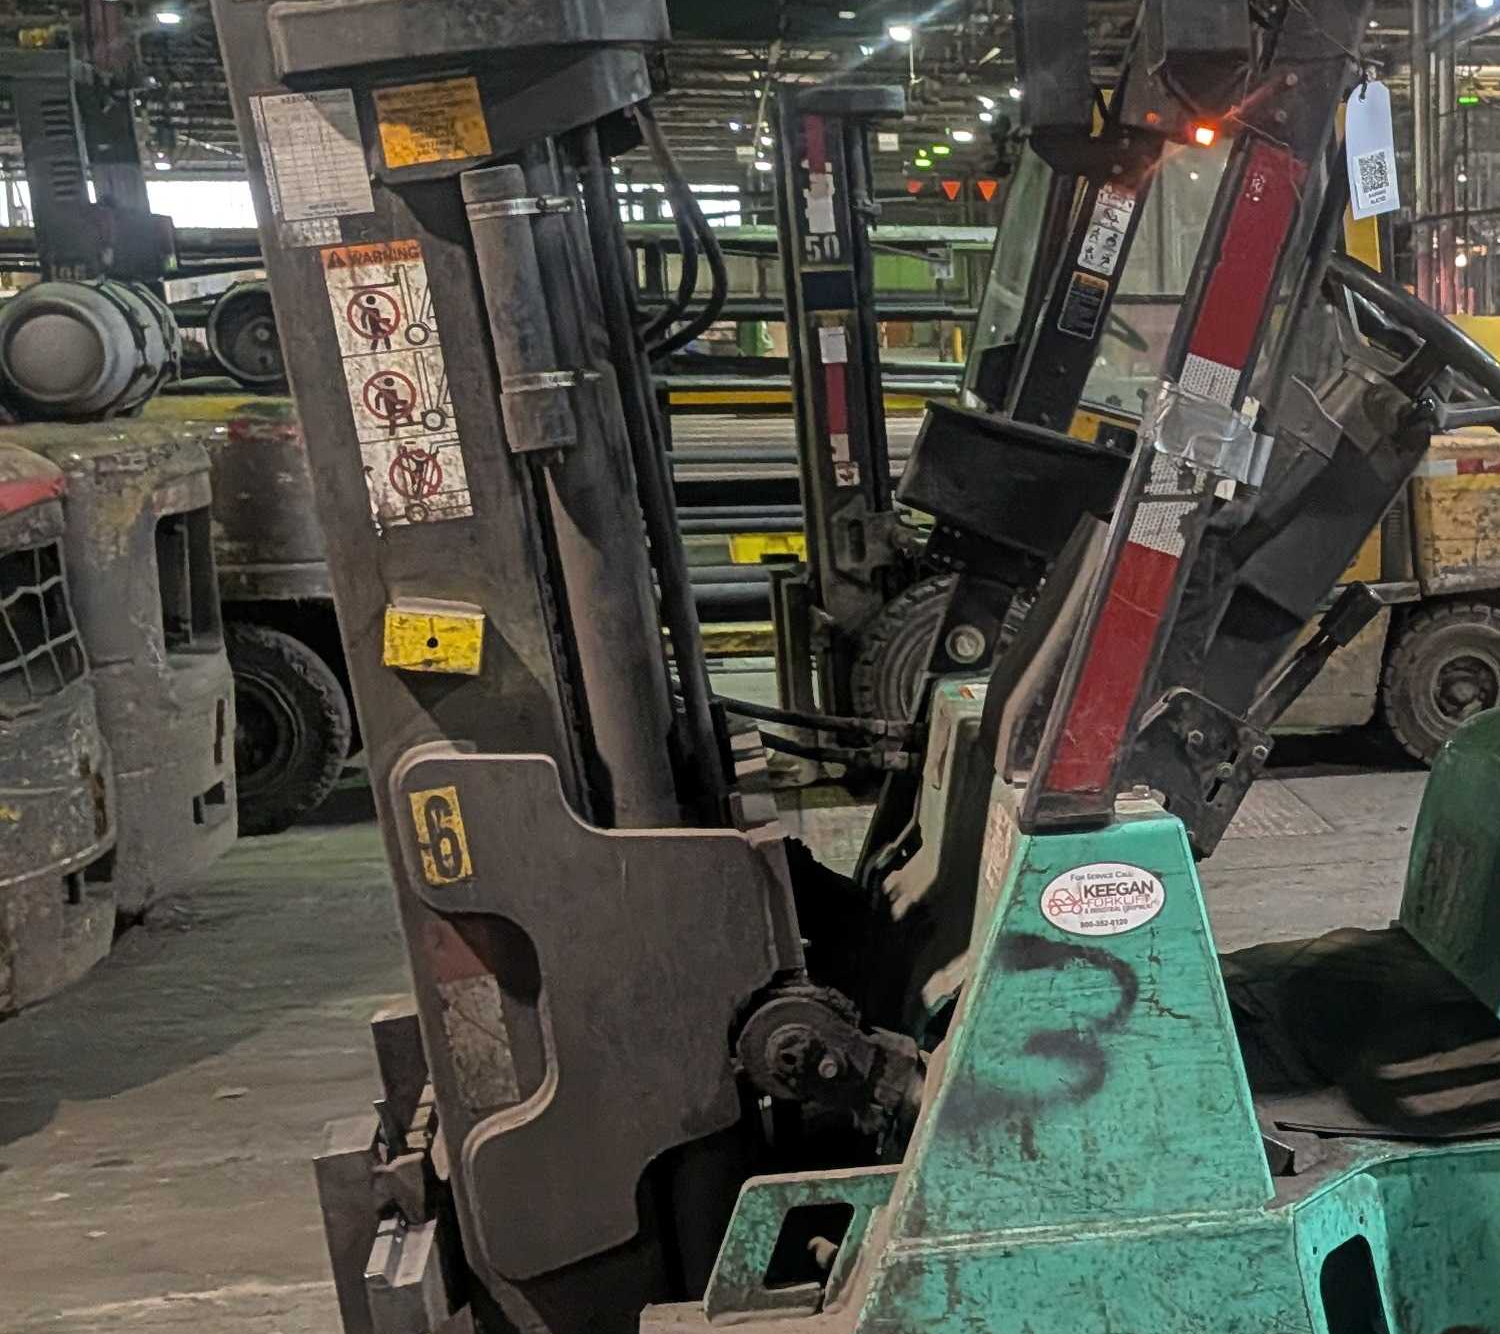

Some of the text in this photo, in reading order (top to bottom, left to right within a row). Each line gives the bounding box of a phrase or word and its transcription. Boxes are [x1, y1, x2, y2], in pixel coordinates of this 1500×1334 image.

[351, 245, 420, 265] WARNING
[804, 235, 841, 262] 50
[425, 795, 463, 879] 6
[1083, 880, 1154, 898] KEEGAN
